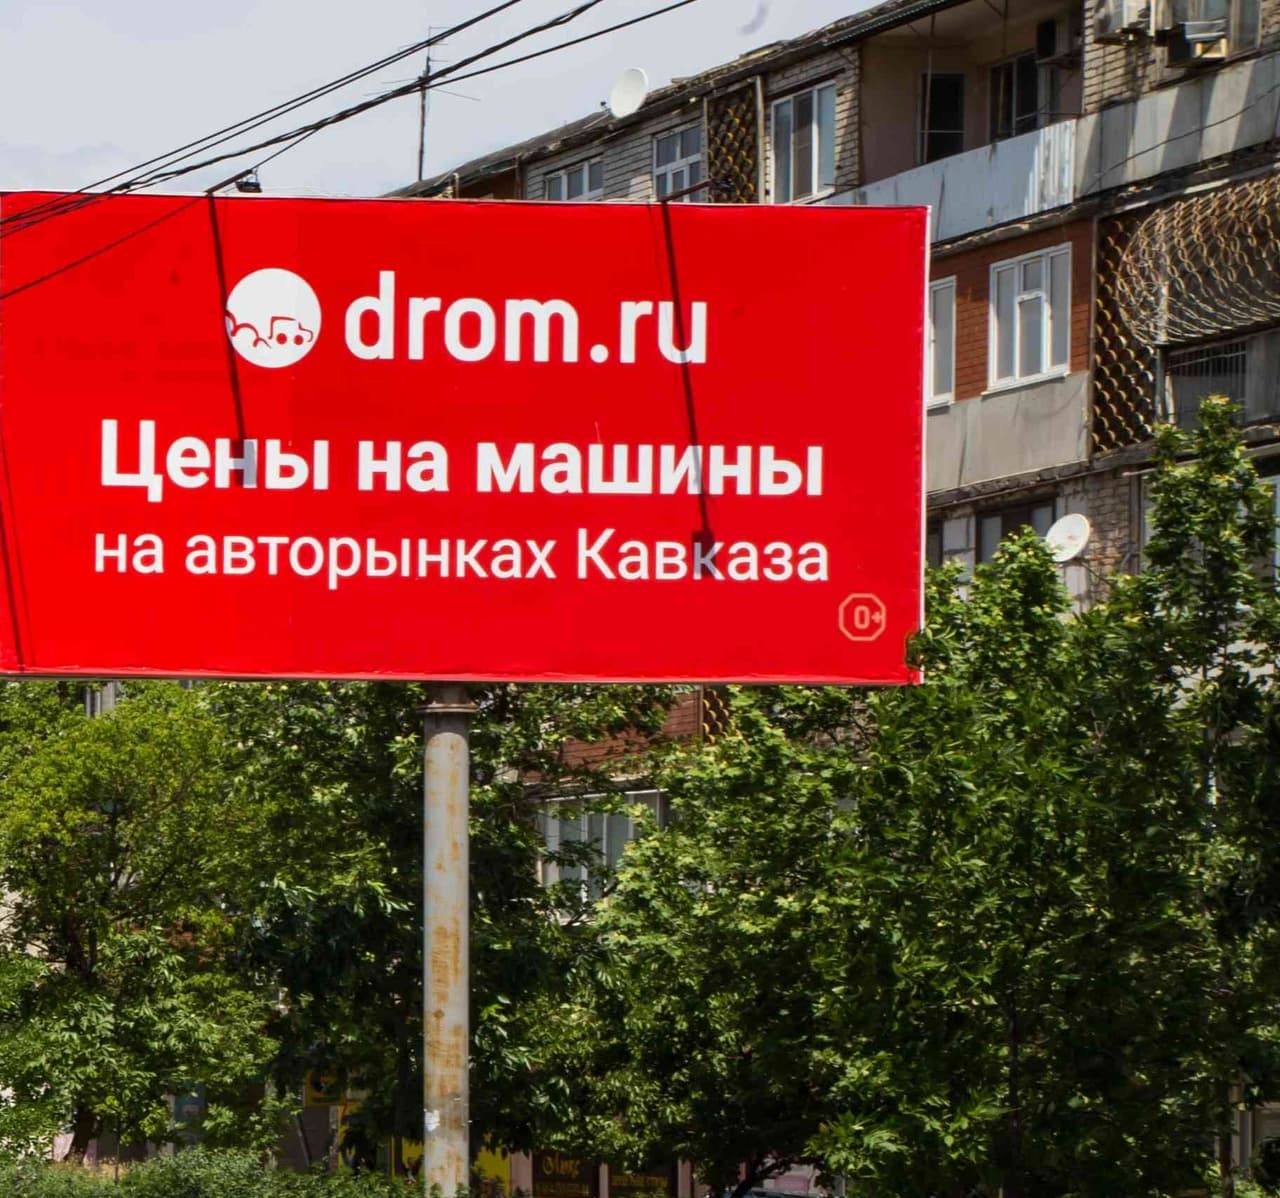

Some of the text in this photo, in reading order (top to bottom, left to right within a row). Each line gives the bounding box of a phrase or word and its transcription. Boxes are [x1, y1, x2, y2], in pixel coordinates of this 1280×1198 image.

[344, 267, 708, 365] drom.ru
[100, 417, 824, 503] Цены на машины
[94, 526, 830, 592] на авторынках Кавказа
[853, 604, 884, 630] 0+
